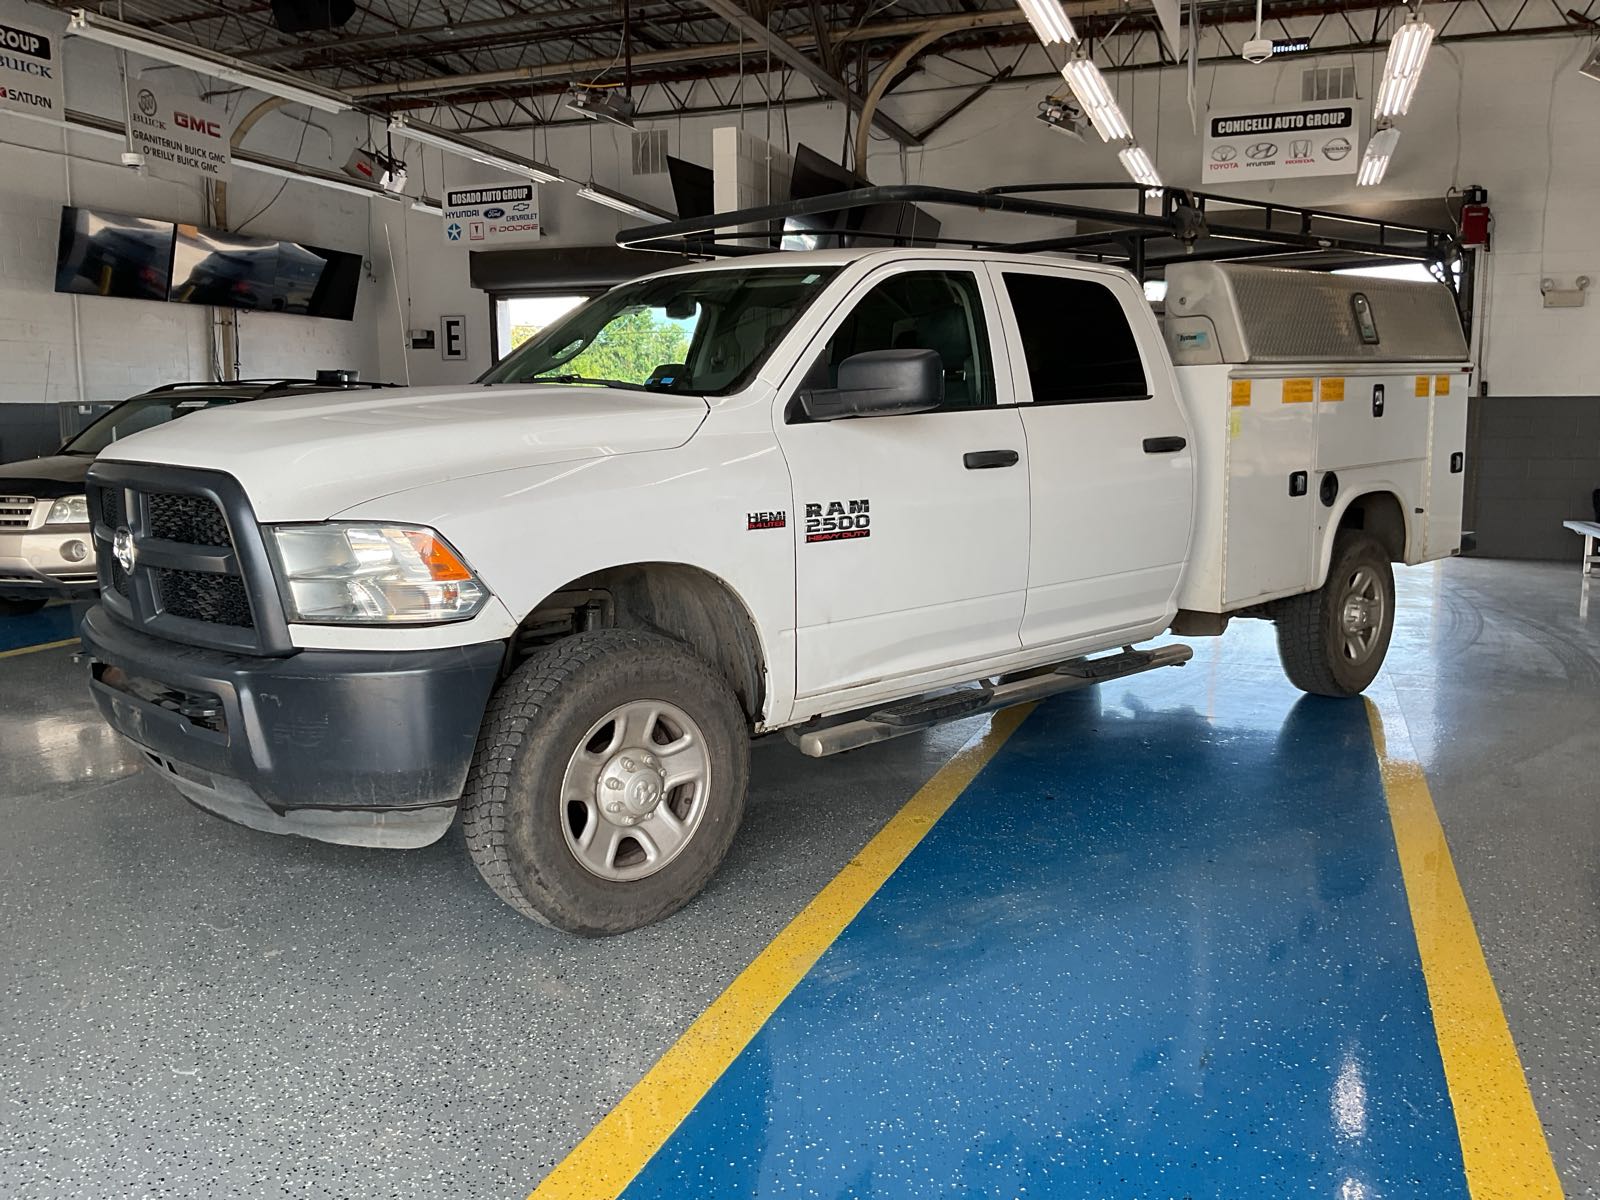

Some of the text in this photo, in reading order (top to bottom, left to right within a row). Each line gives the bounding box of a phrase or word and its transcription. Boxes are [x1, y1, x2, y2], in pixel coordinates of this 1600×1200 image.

[8, 88, 52, 109] SATURN
[132, 112, 167, 130] BUICK
[173, 110, 221, 139] GMC
[1217, 112, 1346, 134] CONICELLI AUTO GROUP
[132, 129, 226, 165] GRANITERUN BUICK GMC
[142, 145, 218, 174] O'REILLY BUICK GMC
[1210, 162, 1239, 170] TOYOTA
[1246, 160, 1276, 168] HYUNDAI
[451, 187, 528, 205] ROSADO AUTO GROUP
[445, 209, 480, 220] HYUNDAI
[506, 212, 537, 222] CHEVROLET
[498, 223, 539, 233] DODGE
[446, 320, 461, 355] E
[747, 511, 786, 523] HEMI
[805, 499, 870, 518] RAM
[763, 520, 785, 528] LITER
[806, 514, 870, 533] 2500
[807, 530, 869, 542] HEAVY DUTY
